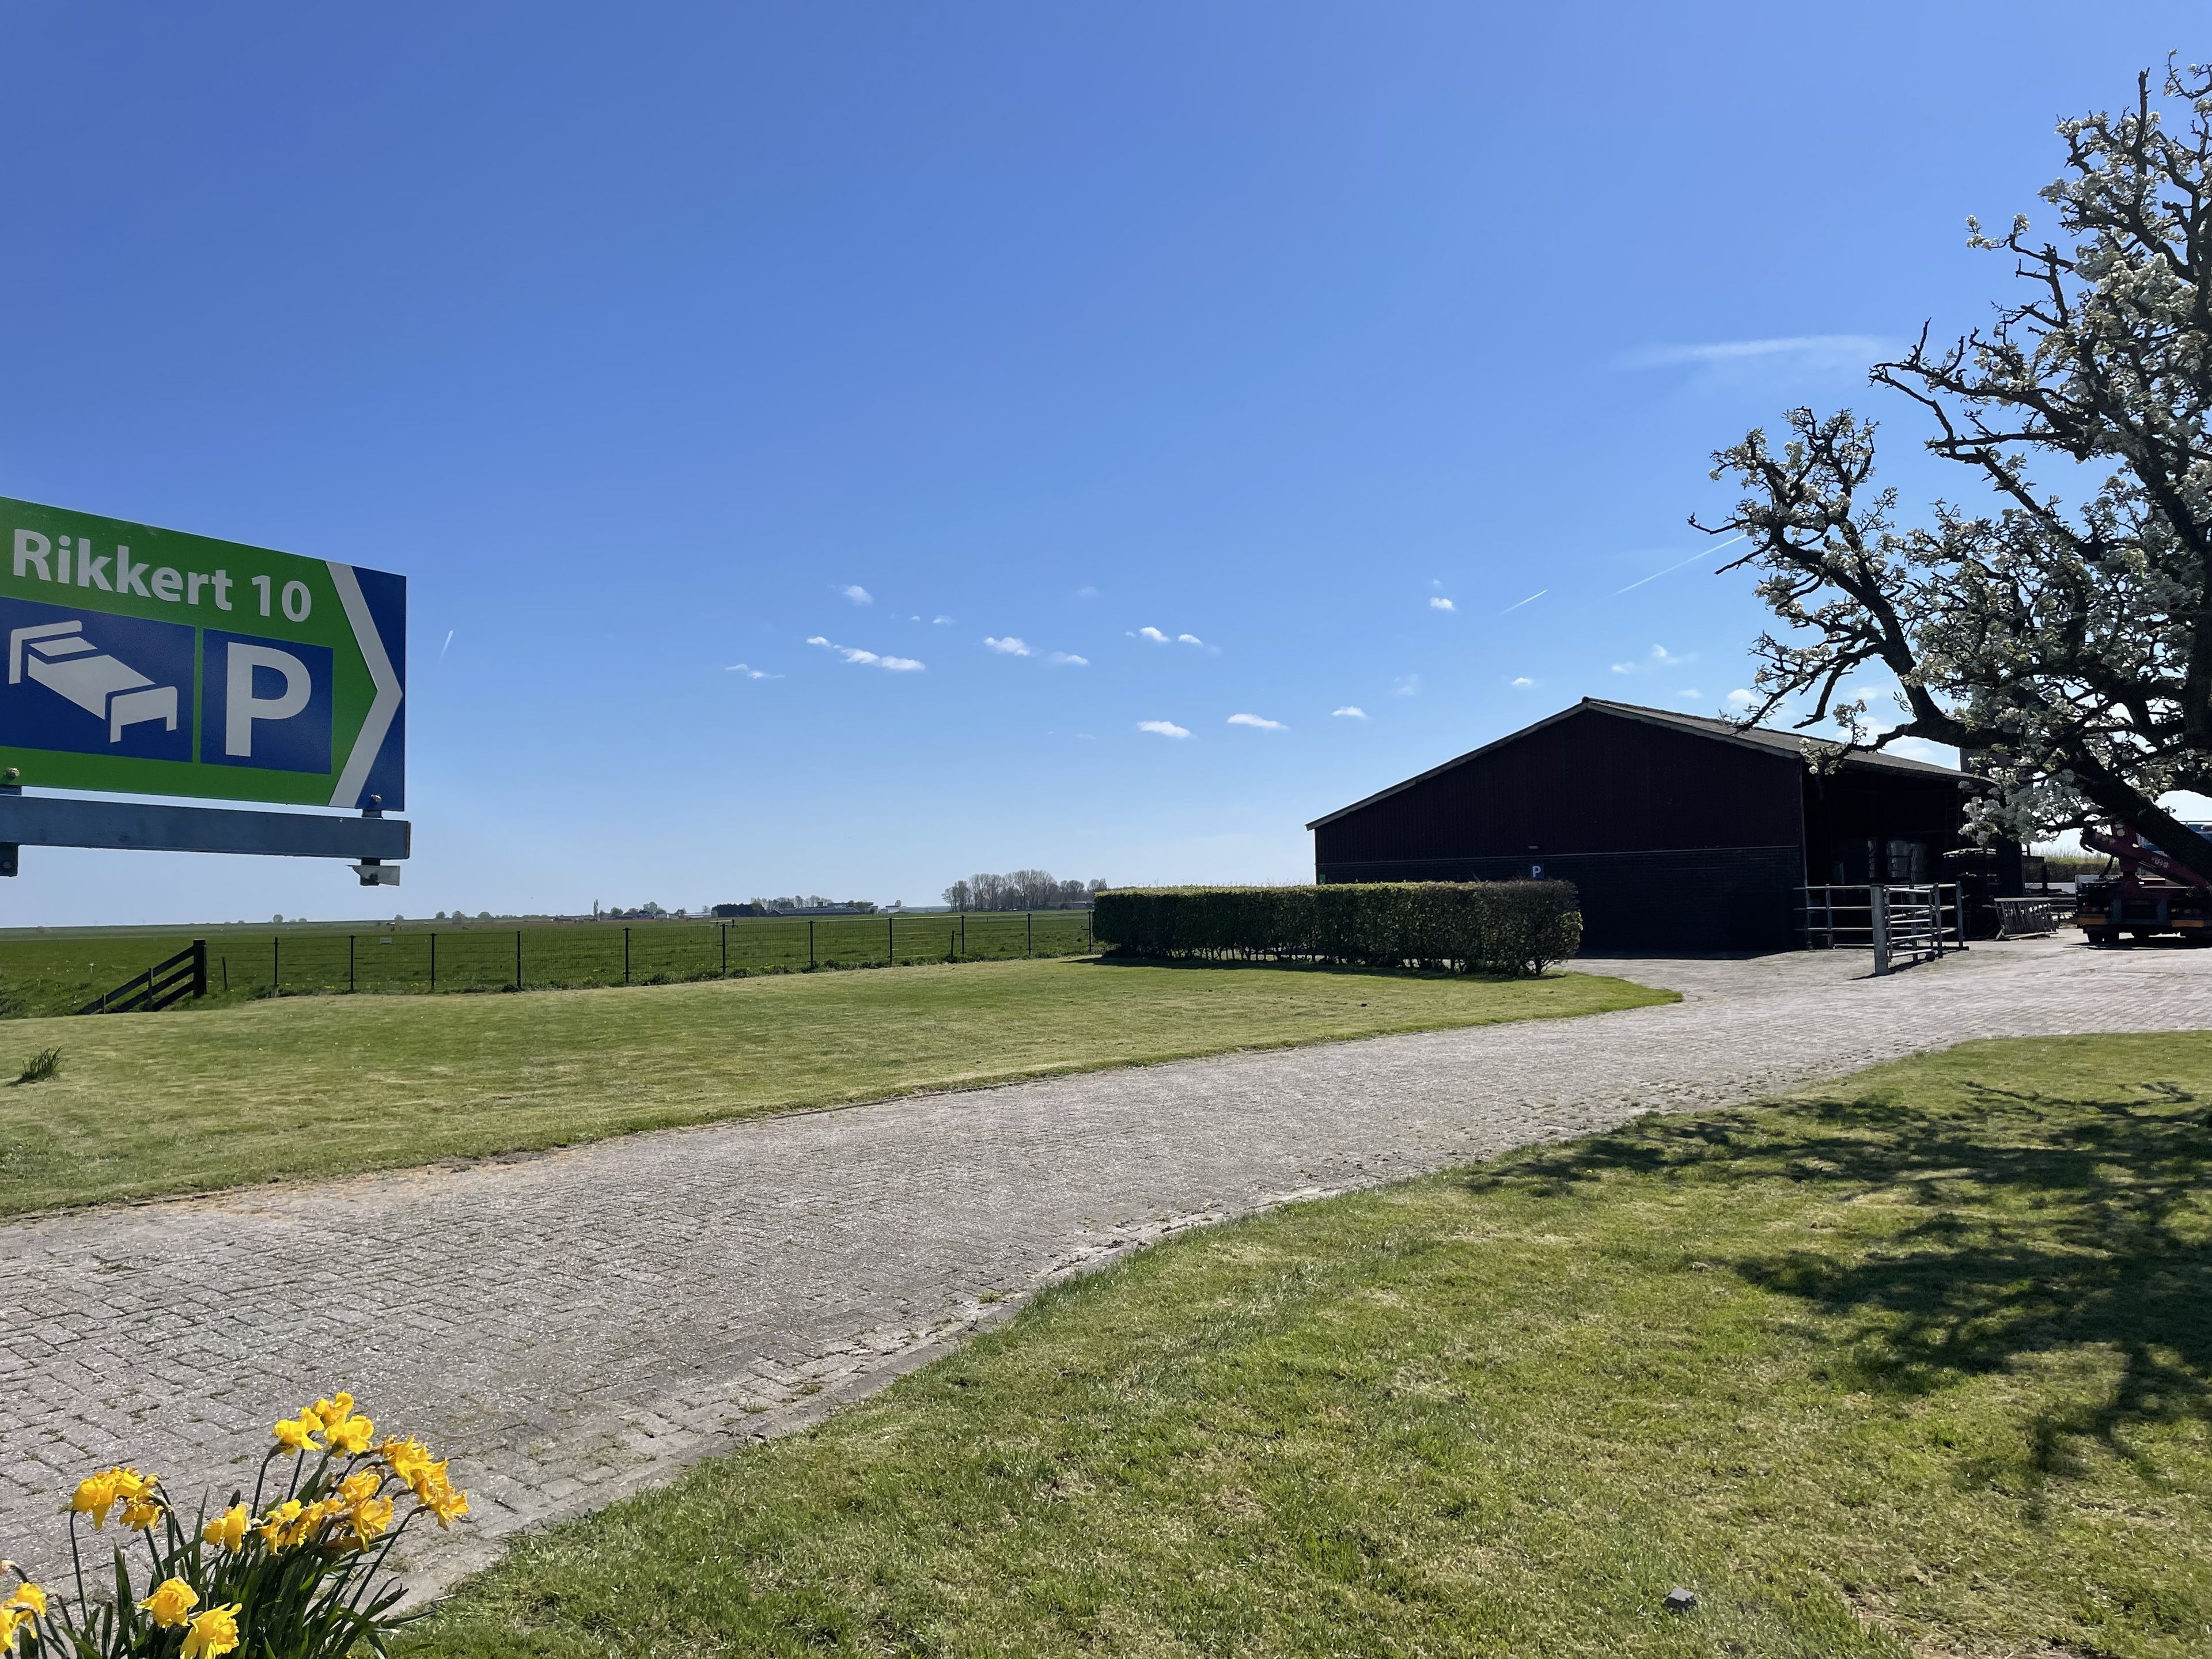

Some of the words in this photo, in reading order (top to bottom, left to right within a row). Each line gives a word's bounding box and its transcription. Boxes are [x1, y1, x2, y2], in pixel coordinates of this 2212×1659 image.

[13, 529, 233, 611] Rikkert
[251, 575, 312, 623] 10
[225, 641, 312, 757] P
[1532, 865, 1541, 878] P
